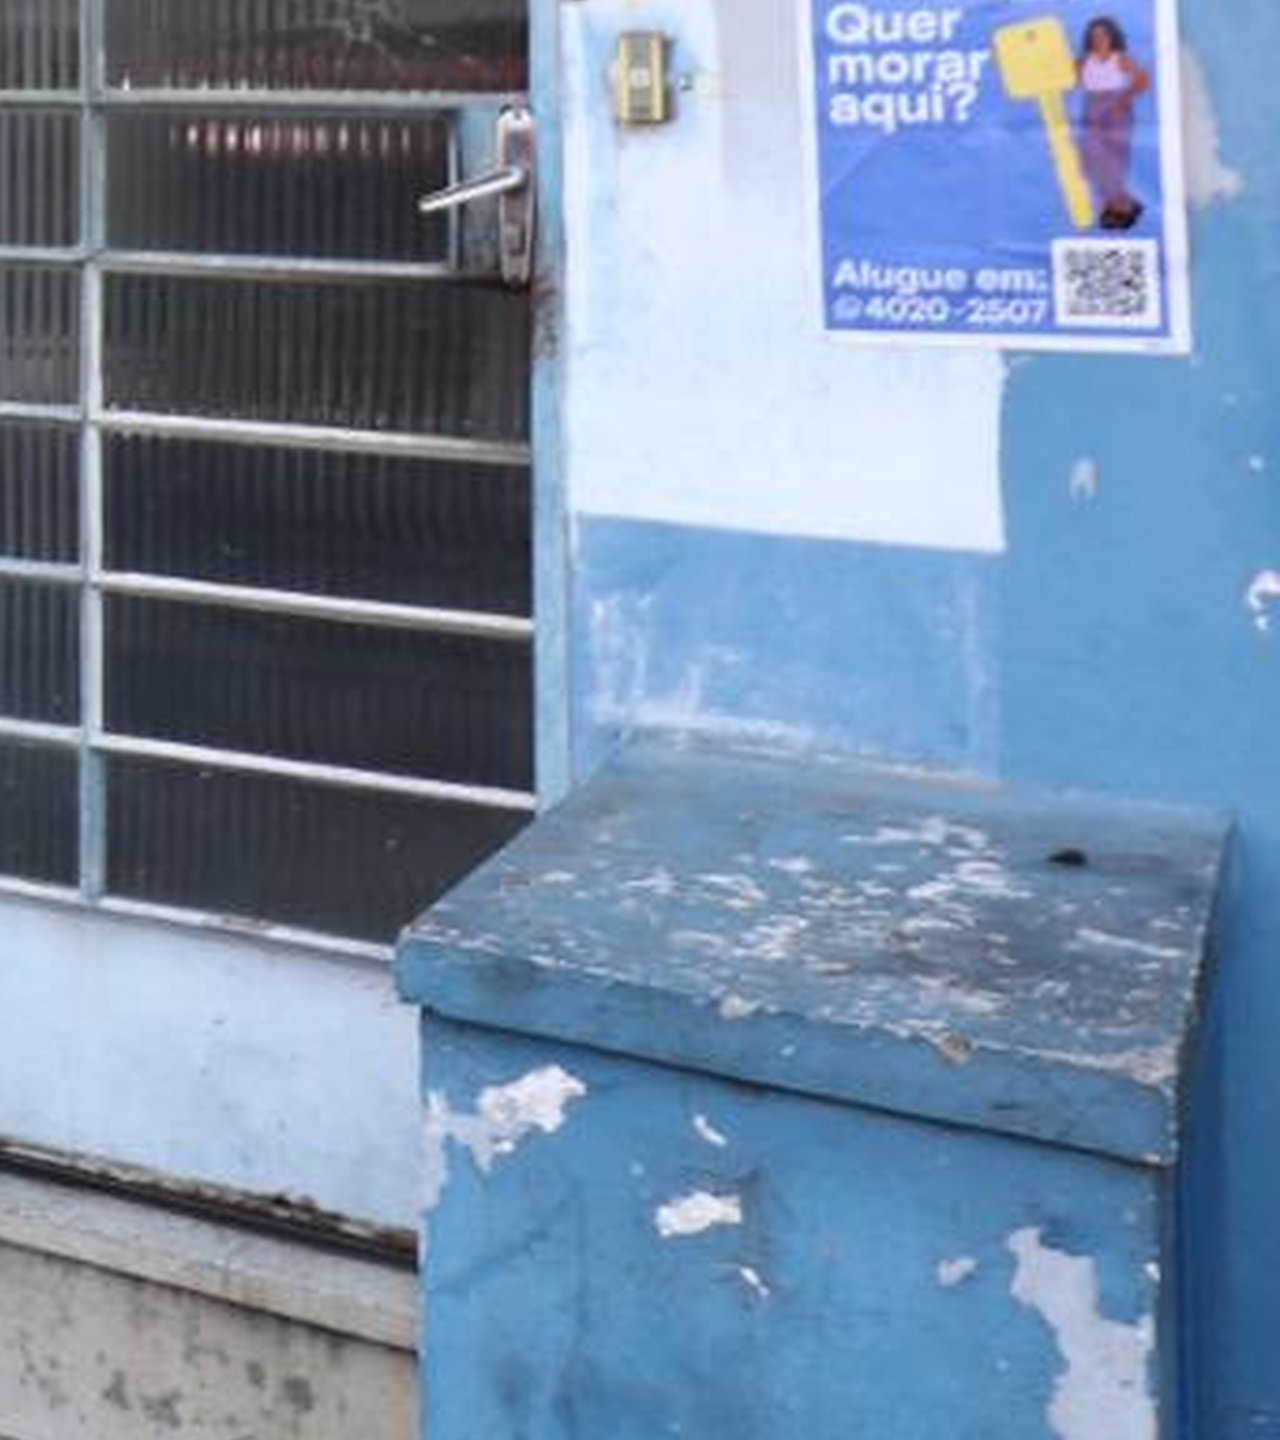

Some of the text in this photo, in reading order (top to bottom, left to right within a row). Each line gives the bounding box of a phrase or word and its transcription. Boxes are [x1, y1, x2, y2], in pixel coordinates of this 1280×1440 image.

[825, 3, 962, 43] Quer
[828, 49, 990, 83] morar
[830, 82, 979, 133] aqui?
[833, 259, 1048, 296] Alugue em:
